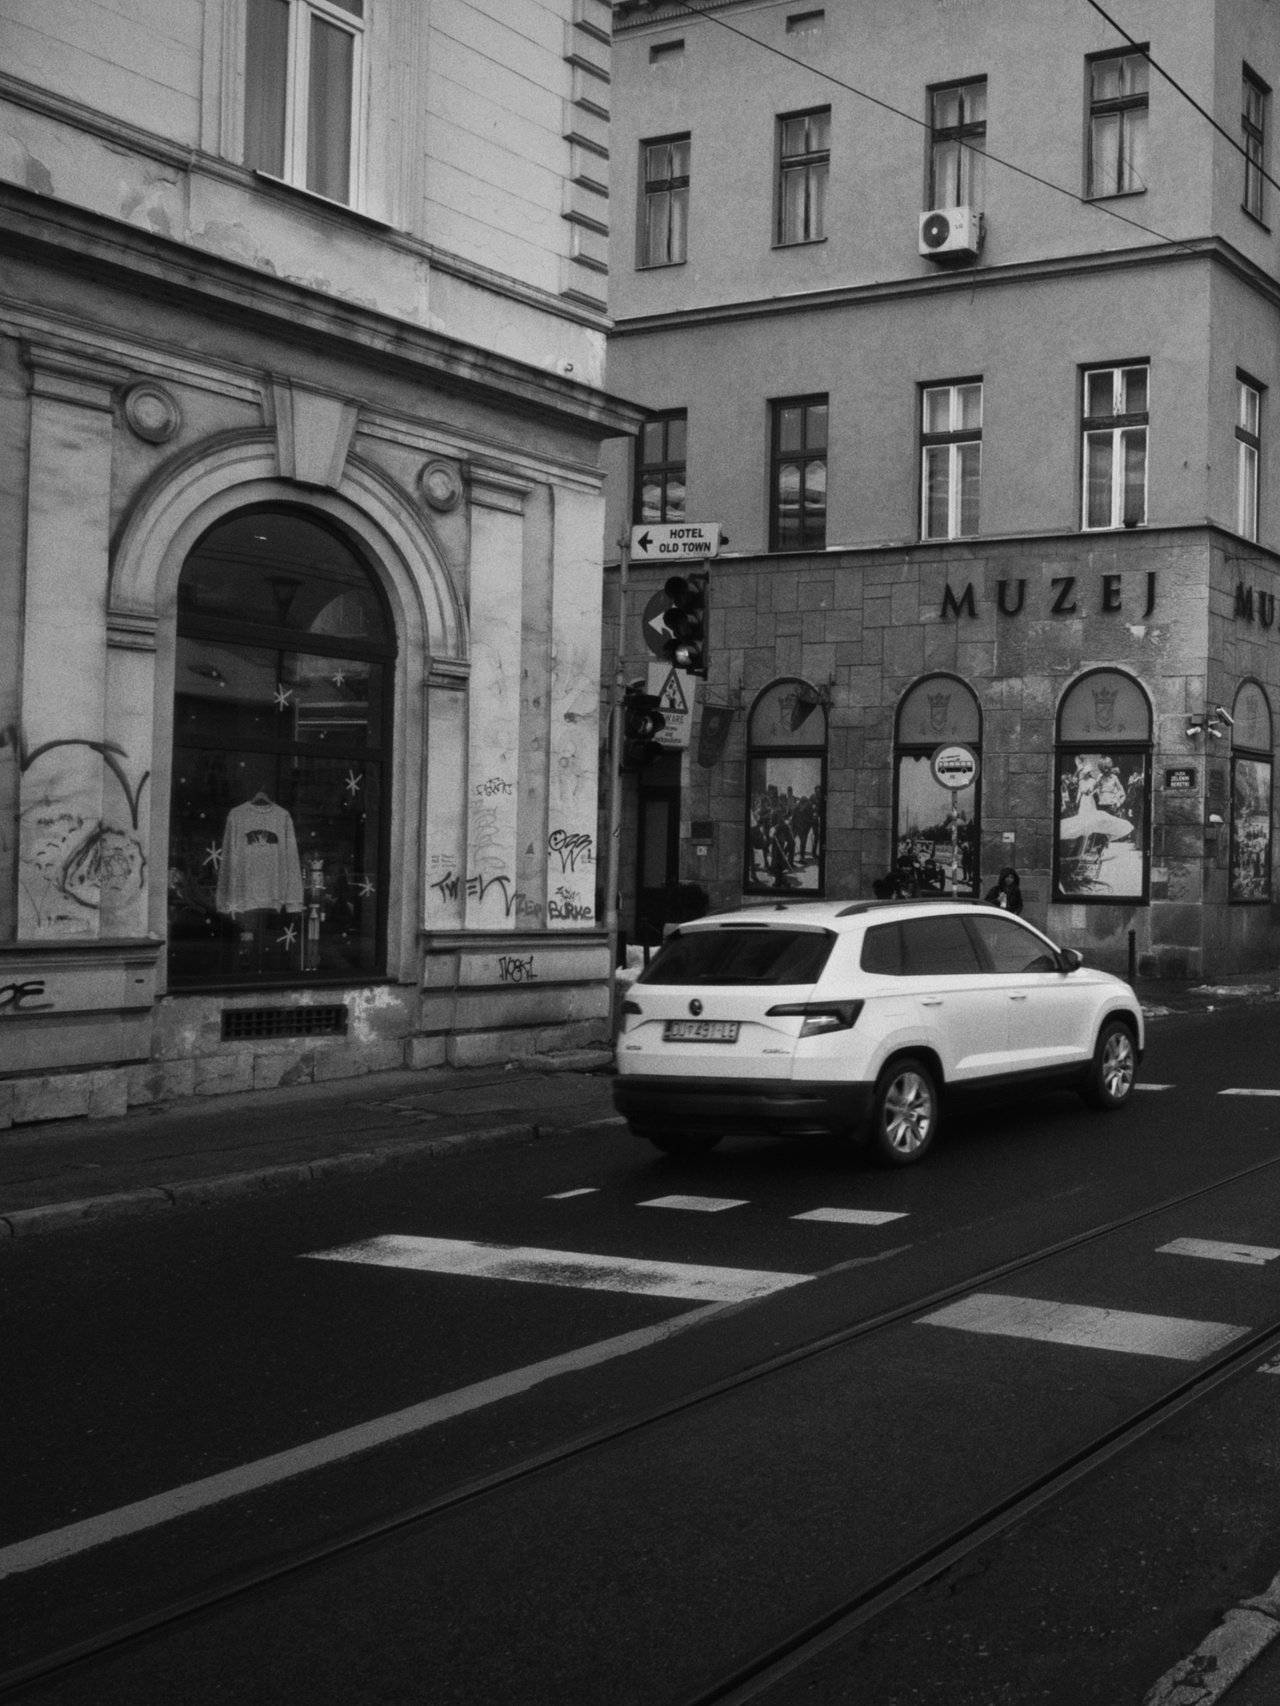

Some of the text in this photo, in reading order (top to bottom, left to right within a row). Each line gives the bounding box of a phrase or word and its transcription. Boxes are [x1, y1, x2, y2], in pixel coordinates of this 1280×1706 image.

[669, 528, 704, 539] HOTEL
[659, 542, 711, 553] OLD TOWN
[939, 571, 1157, 619] MUZEJ
